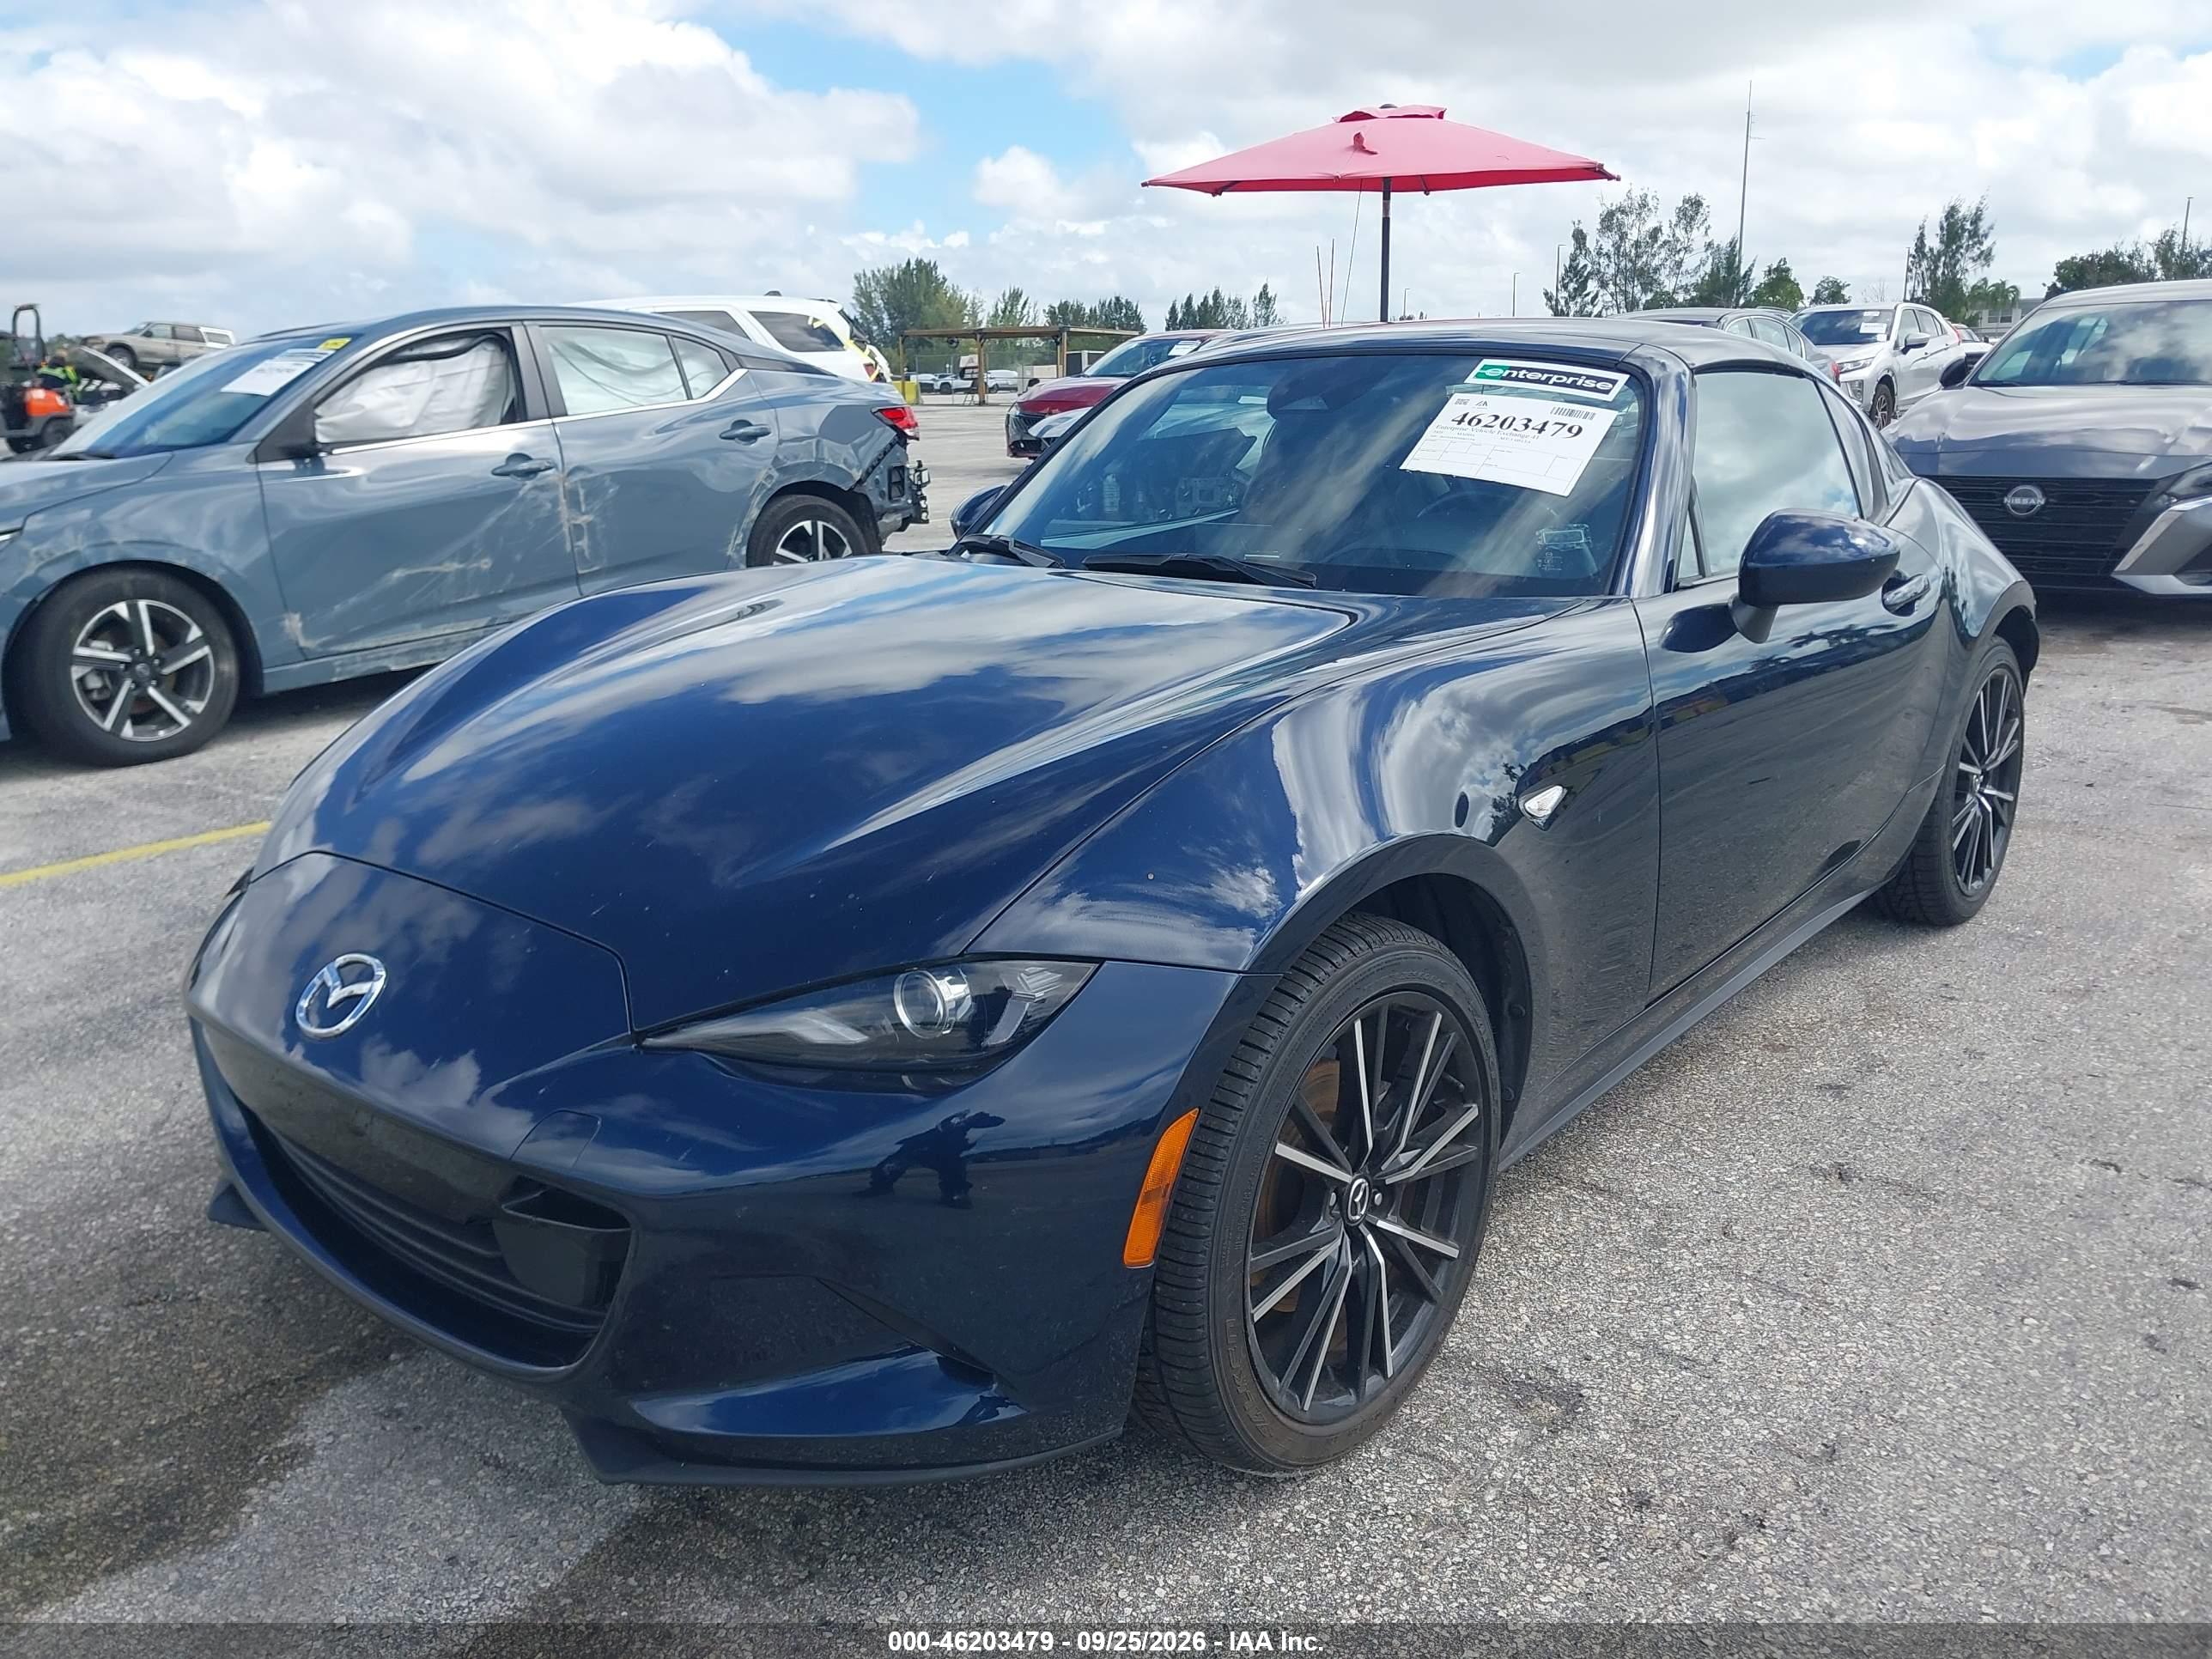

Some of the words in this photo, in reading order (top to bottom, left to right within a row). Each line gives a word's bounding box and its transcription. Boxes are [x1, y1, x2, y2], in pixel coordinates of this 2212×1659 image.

[1481, 368, 1613, 390] enterprise
[1451, 411, 1583, 439] 46203479
[2003, 496, 2046, 505] NISSAN
